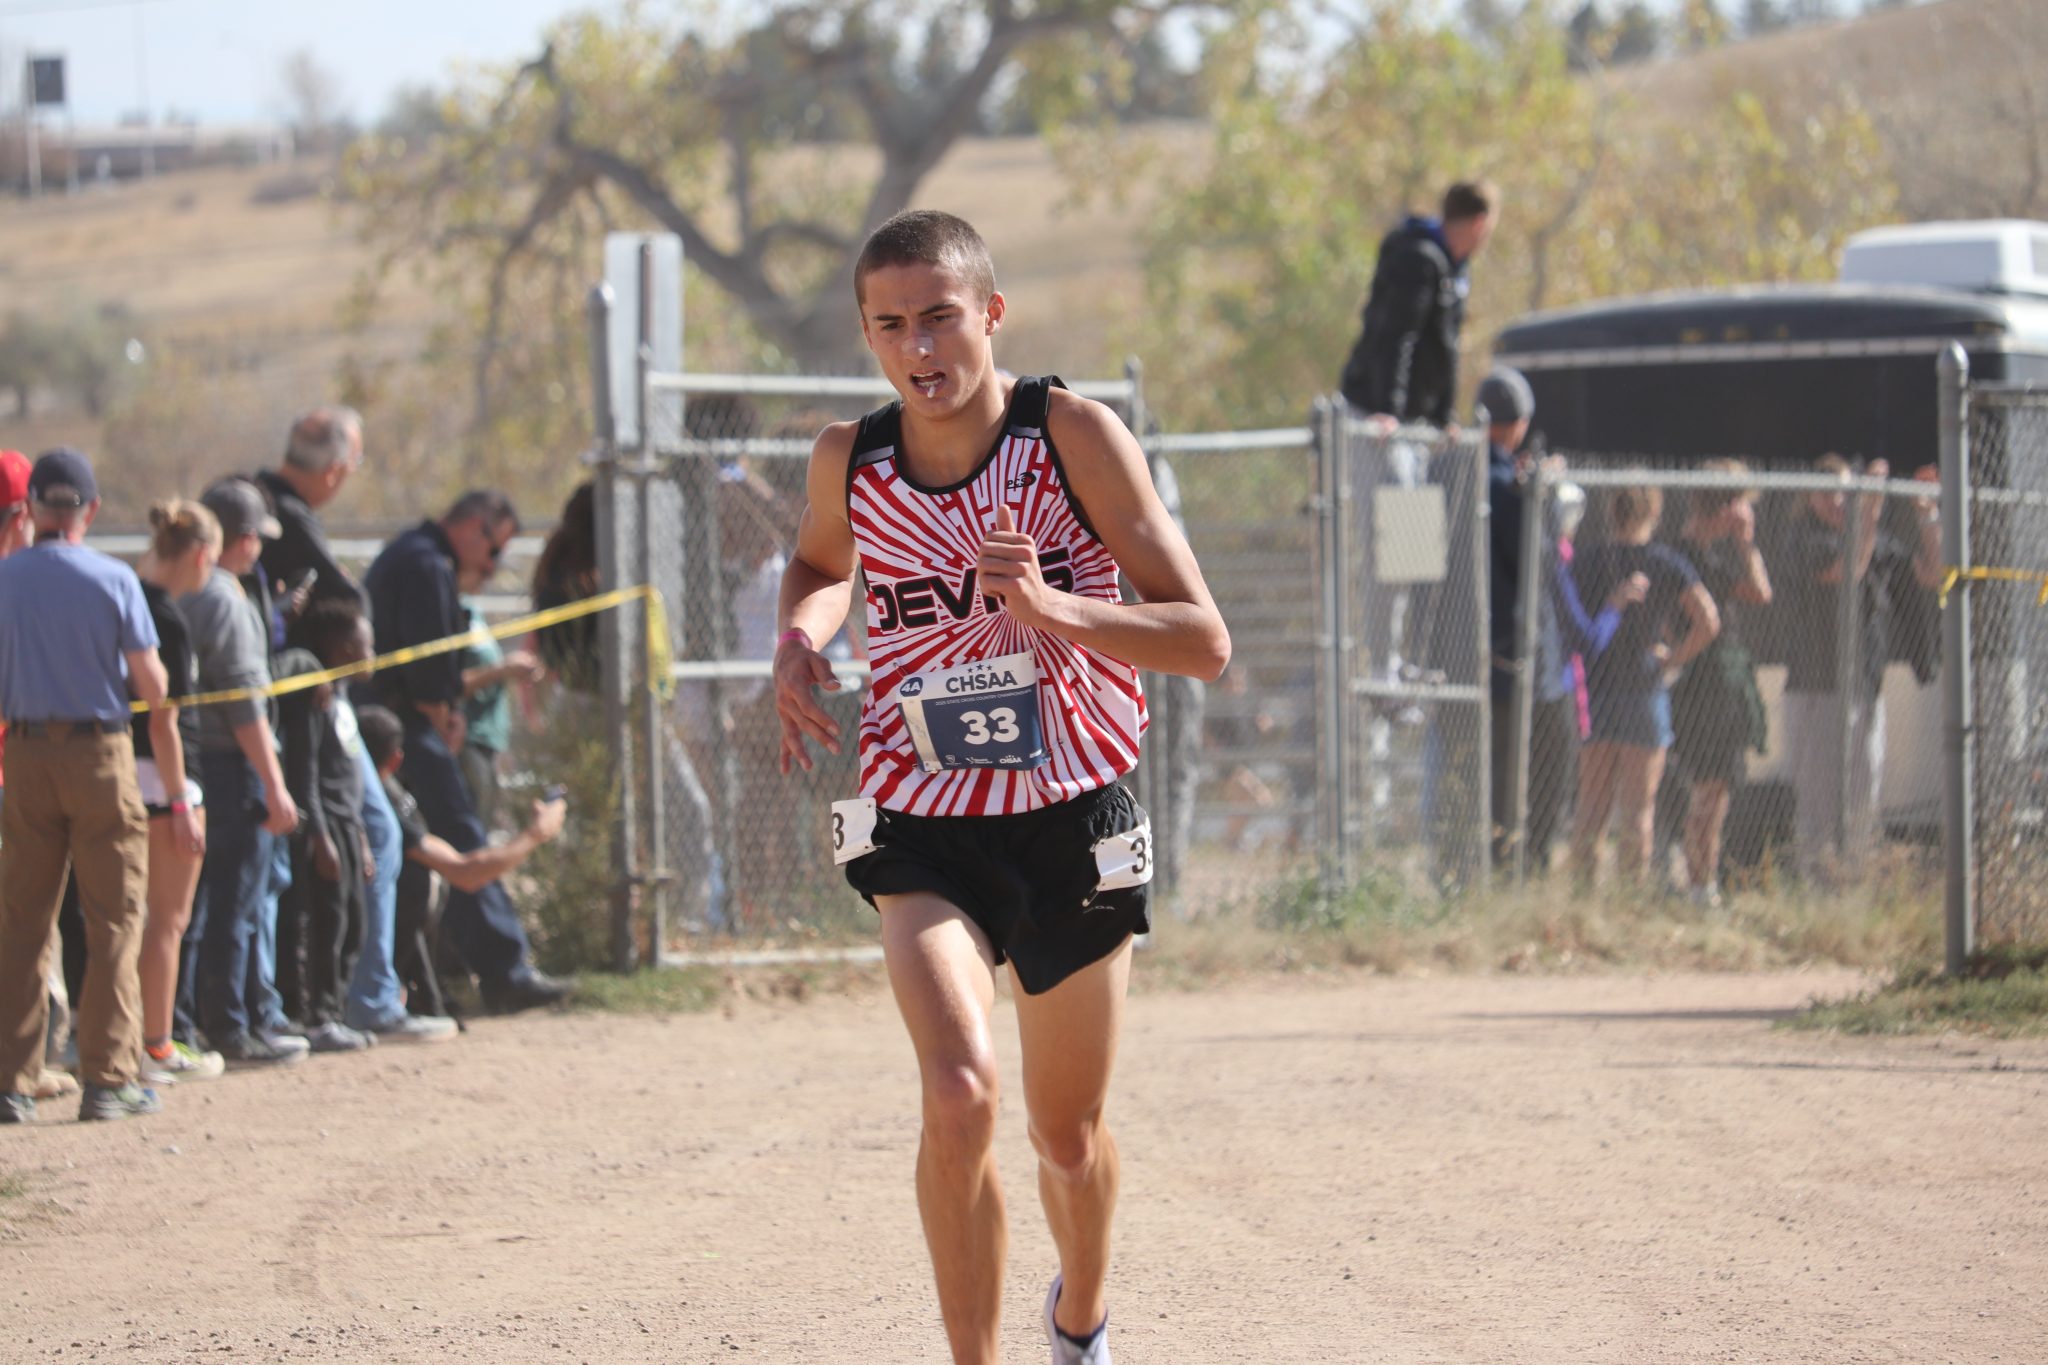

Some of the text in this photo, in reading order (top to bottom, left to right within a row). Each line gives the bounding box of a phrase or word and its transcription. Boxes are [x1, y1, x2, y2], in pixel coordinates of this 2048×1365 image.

[901, 681, 921, 693] 4A
[946, 671, 1018, 693] CHSAA
[960, 707, 1020, 745] 33
[1130, 837, 1153, 874] 3
